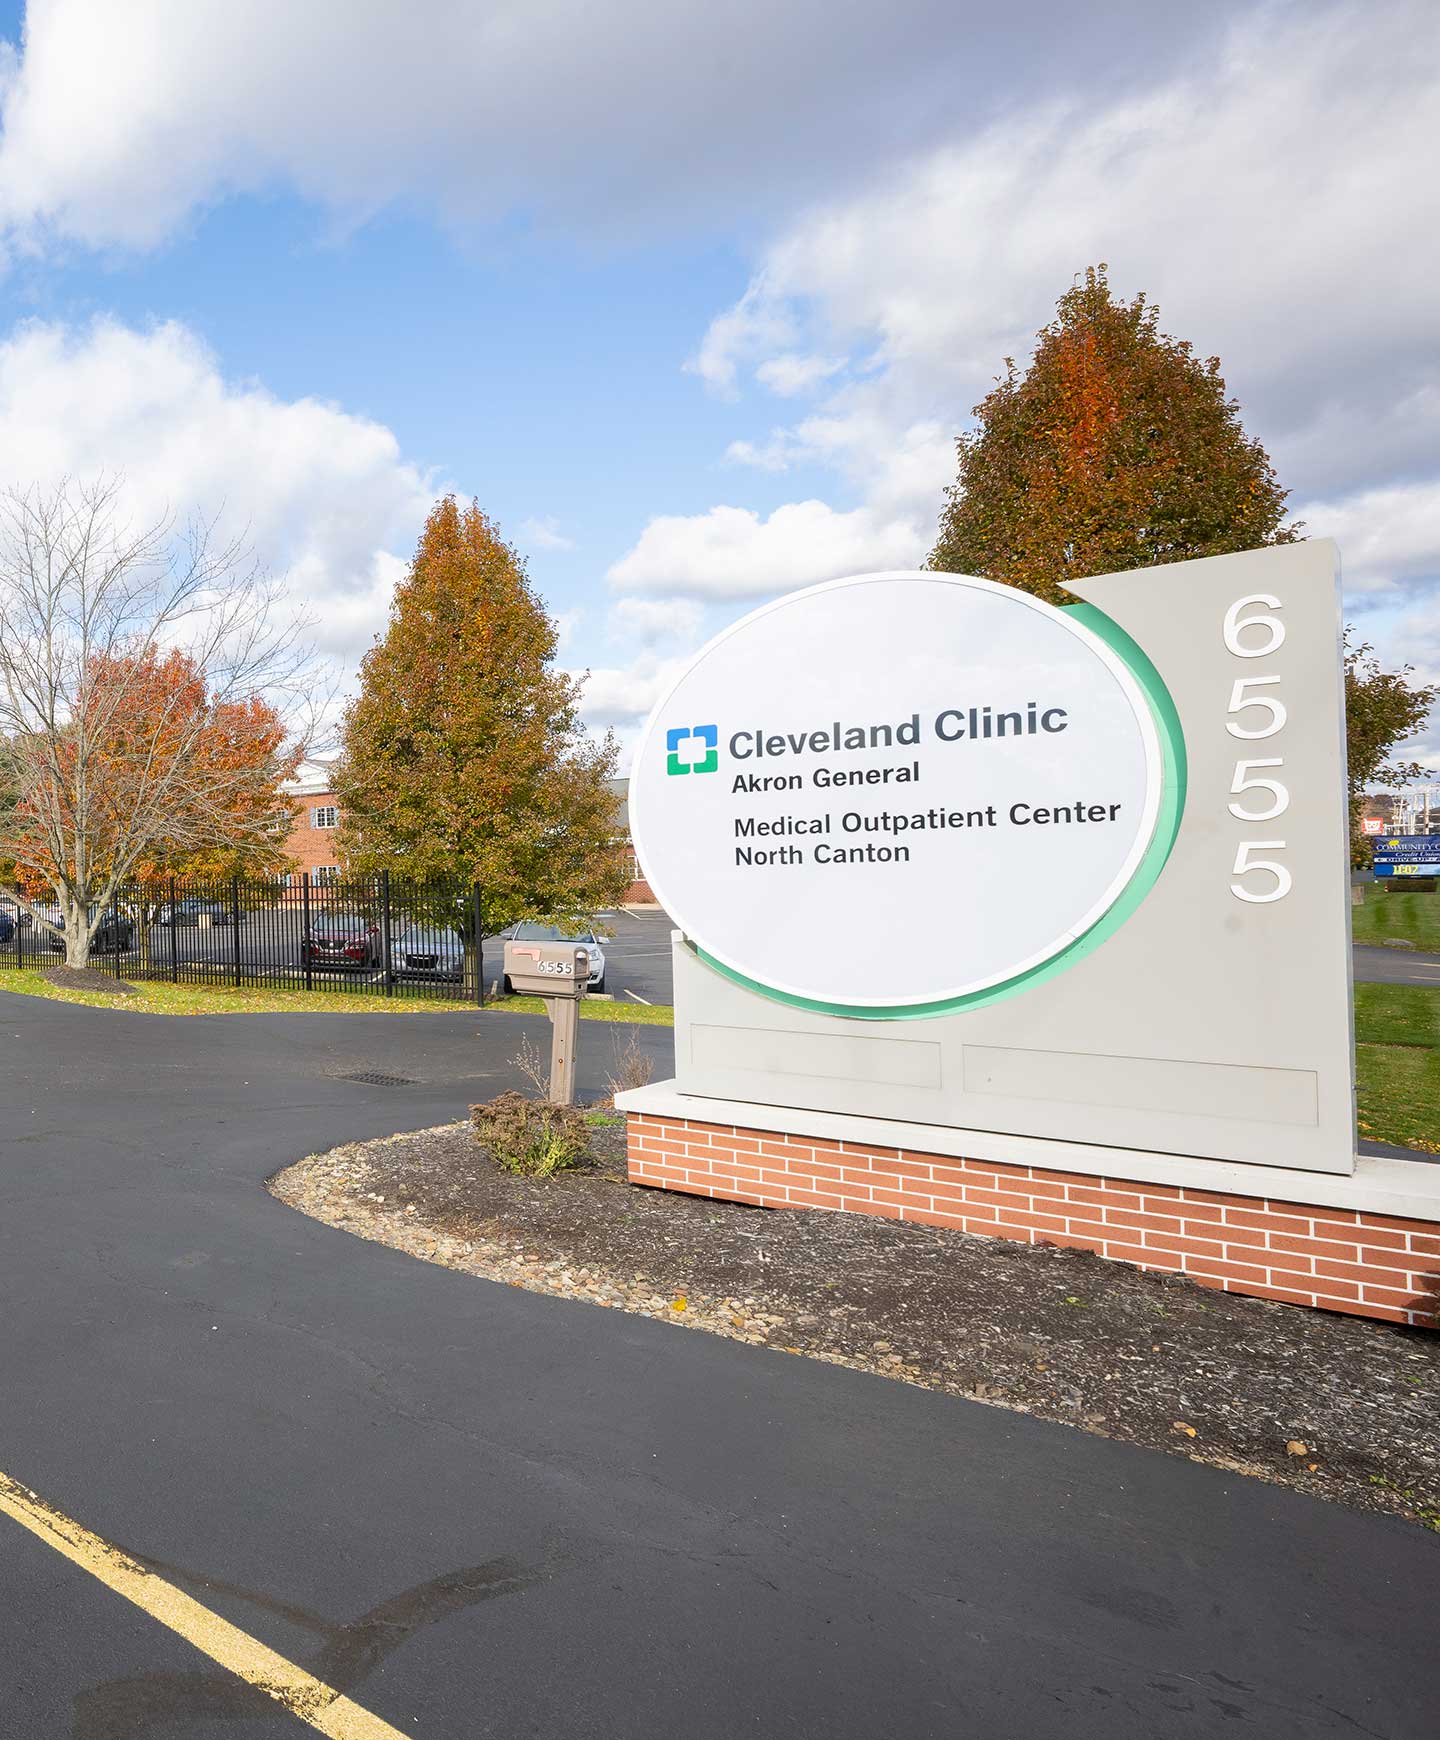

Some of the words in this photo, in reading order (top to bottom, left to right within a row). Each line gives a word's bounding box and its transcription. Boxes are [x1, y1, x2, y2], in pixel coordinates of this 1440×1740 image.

[729, 714, 921, 760] Cleveland
[934, 702, 1069, 742] Clinic
[1222, 594, 1293, 904] 6555
[731, 773, 803, 794] Akron
[812, 761, 920, 788] General
[734, 813, 831, 837] Medical
[841, 806, 997, 836] Outpatient
[1009, 801, 1122, 826] Center
[735, 845, 803, 866] North
[813, 843, 910, 864] Canton
[538, 961, 572, 974] 6555
